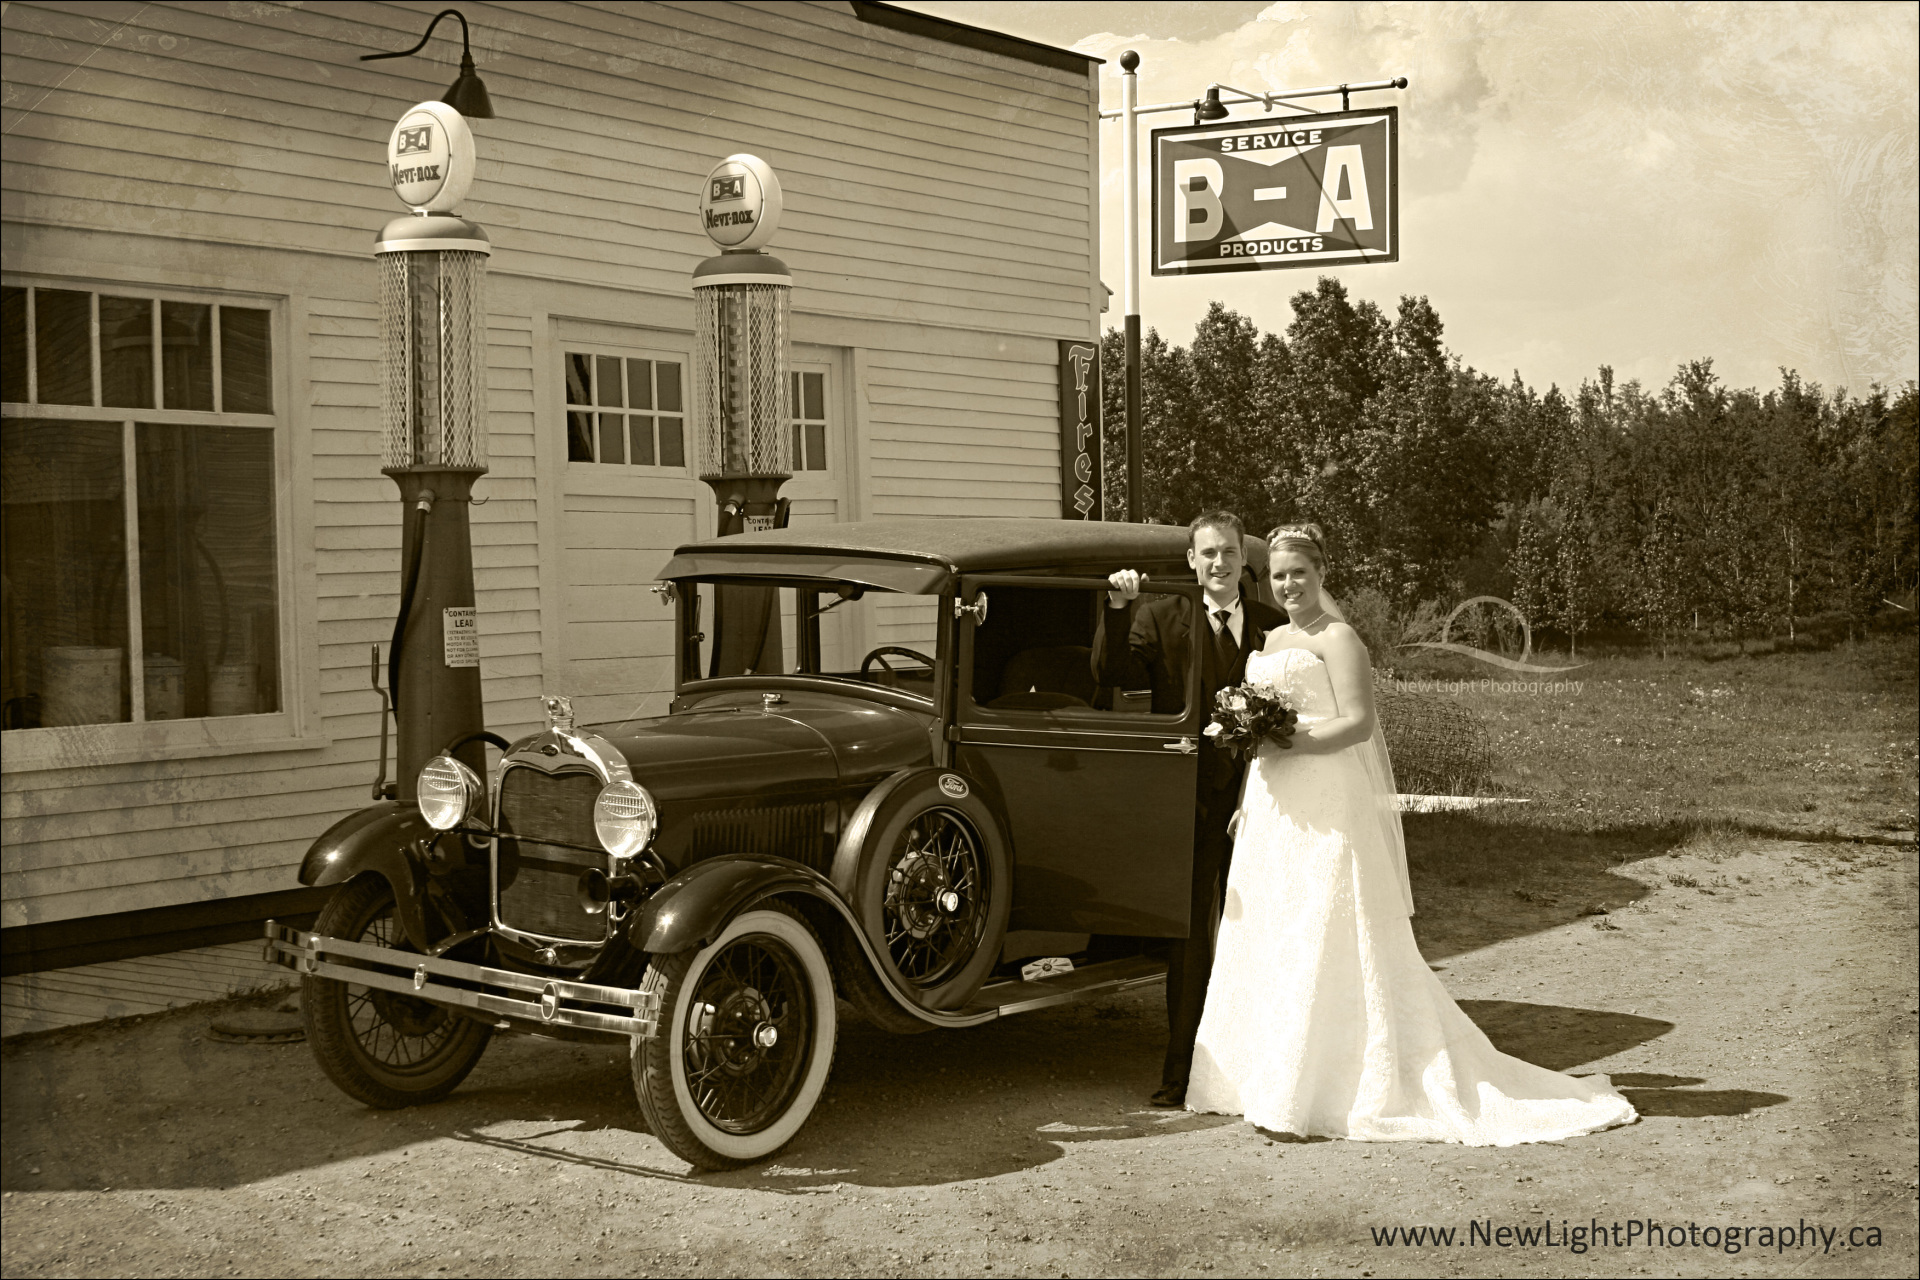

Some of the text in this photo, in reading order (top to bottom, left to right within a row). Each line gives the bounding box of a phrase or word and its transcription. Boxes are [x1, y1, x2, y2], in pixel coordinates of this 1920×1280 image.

[1221, 130, 1322, 152] SERVICE
[1220, 238, 1323, 256] PRODUCTS
[1069, 345, 1095, 521] Fires
[455, 619, 473, 627] LEAD
[944, 778, 964, 792] Ford
